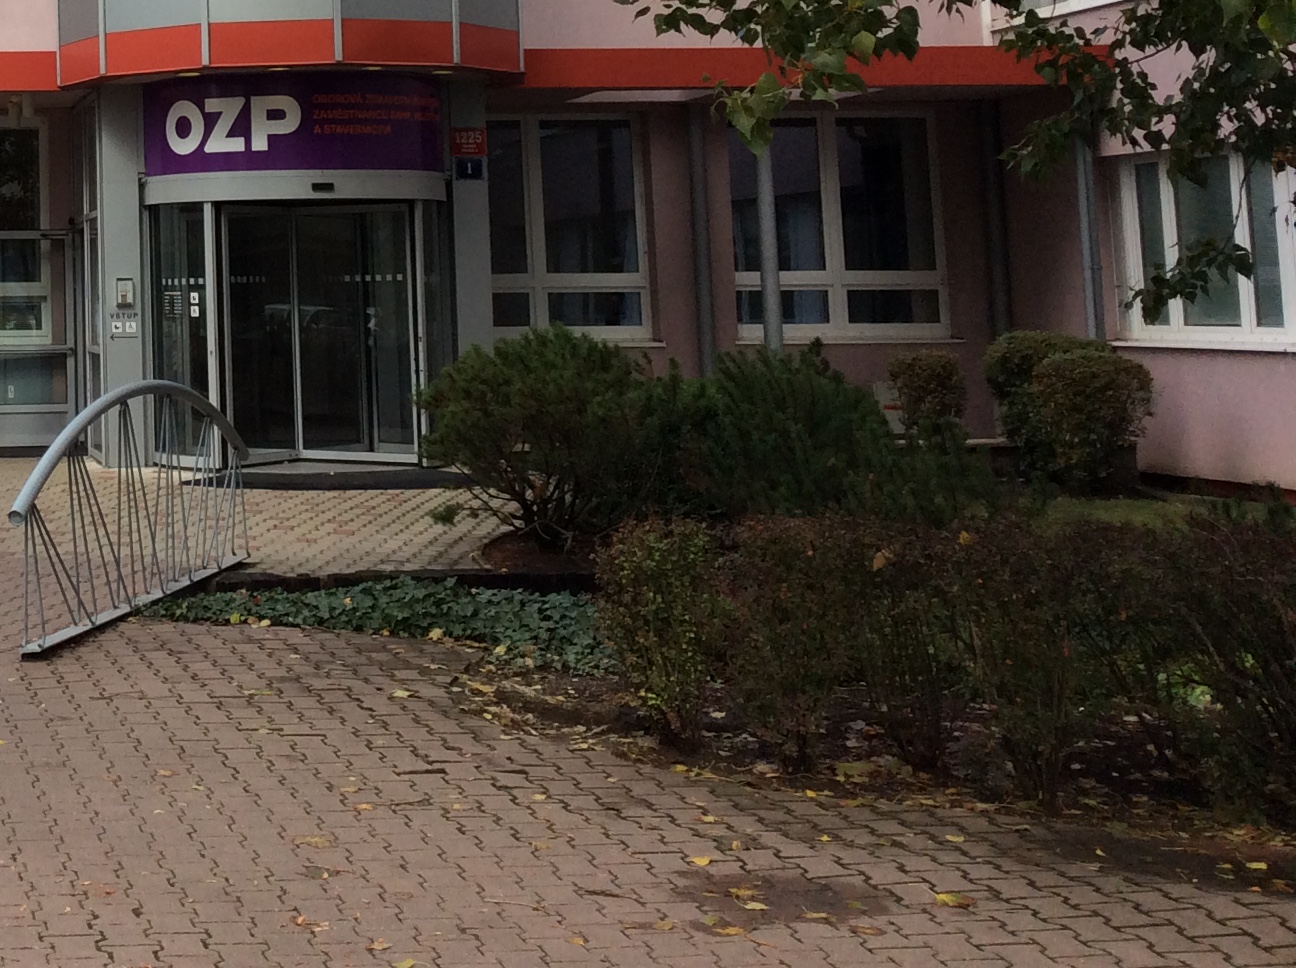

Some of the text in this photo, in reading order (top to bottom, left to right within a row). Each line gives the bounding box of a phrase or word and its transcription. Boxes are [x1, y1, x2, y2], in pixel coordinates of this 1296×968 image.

[165, 95, 302, 156] OZP
[314, 124, 321, 134] A
[456, 131, 482, 143] 1225
[467, 162, 473, 174] 1
